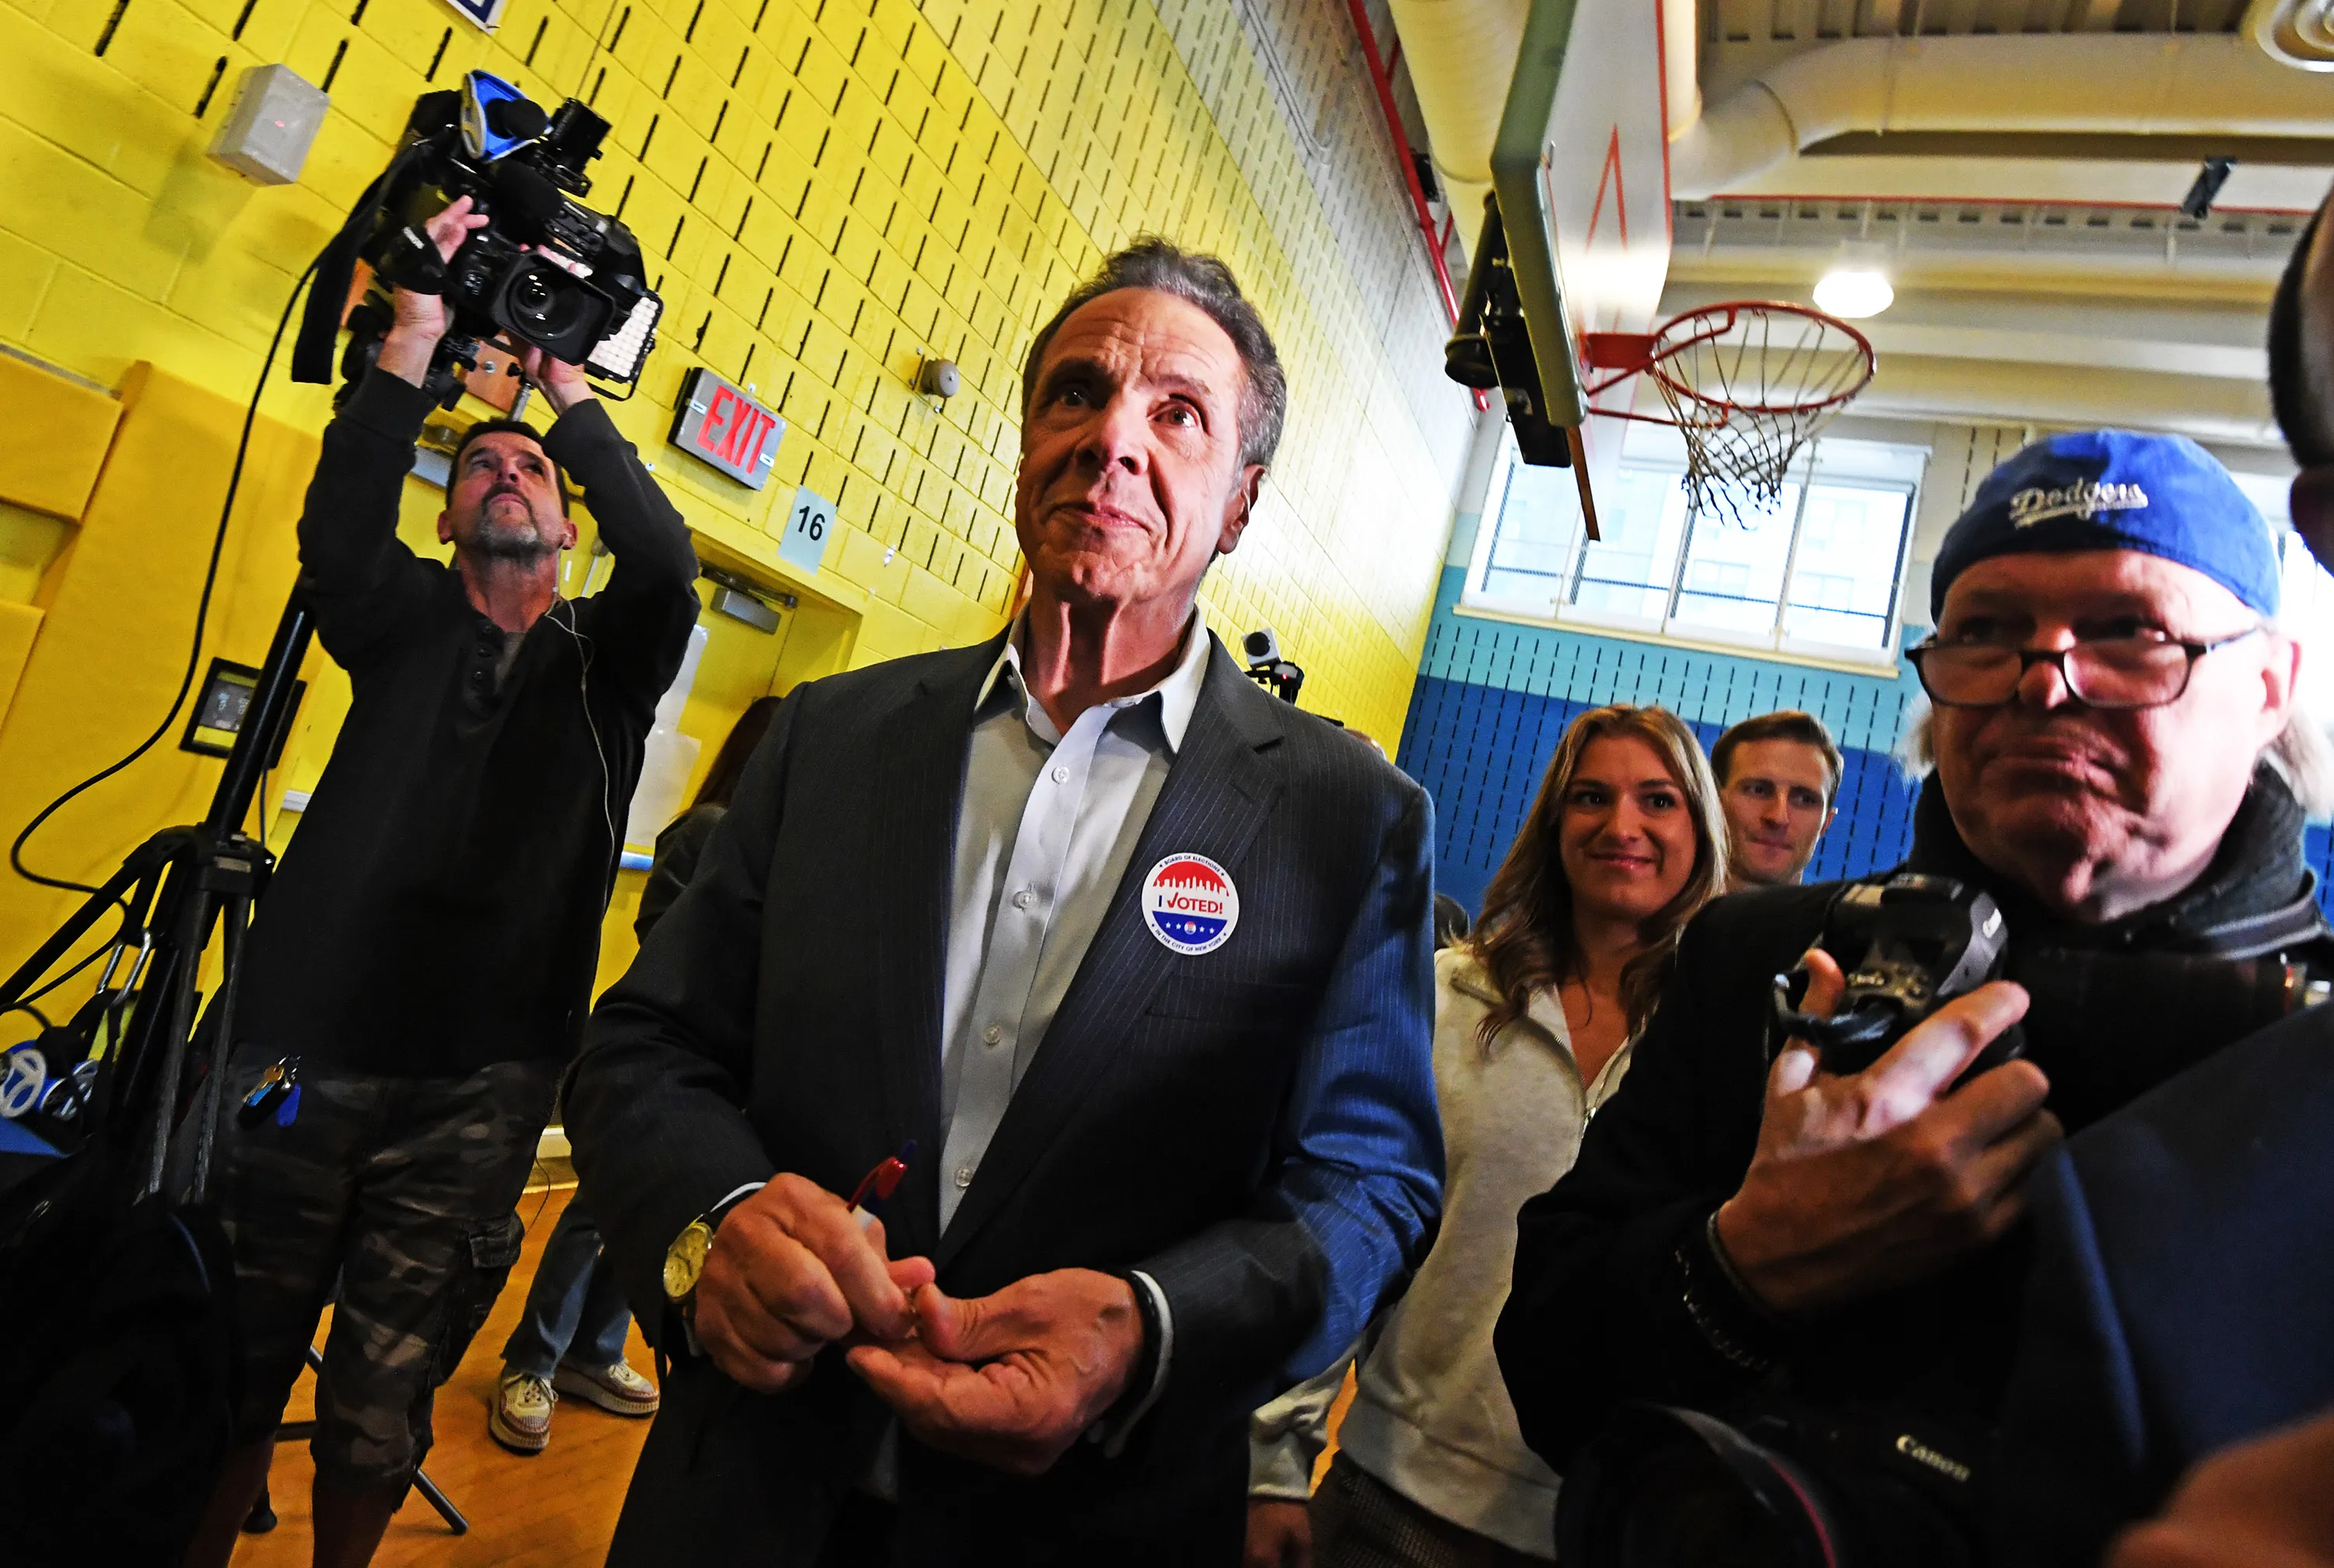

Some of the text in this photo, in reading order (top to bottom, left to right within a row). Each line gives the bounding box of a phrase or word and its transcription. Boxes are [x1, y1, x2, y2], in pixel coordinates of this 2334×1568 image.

[696, 385, 776, 474] EXIT
[2009, 476, 2148, 529] Dodgers
[798, 506, 825, 541] 16
[1165, 856, 1183, 865] BOARD
[1193, 856, 1220, 873] ELECTIONS
[1158, 892, 1223, 914] I VOTED!
[1162, 935, 1170, 943] THE
[1208, 937, 1221, 947] YORK
[1896, 1434, 1971, 1482] Canon
